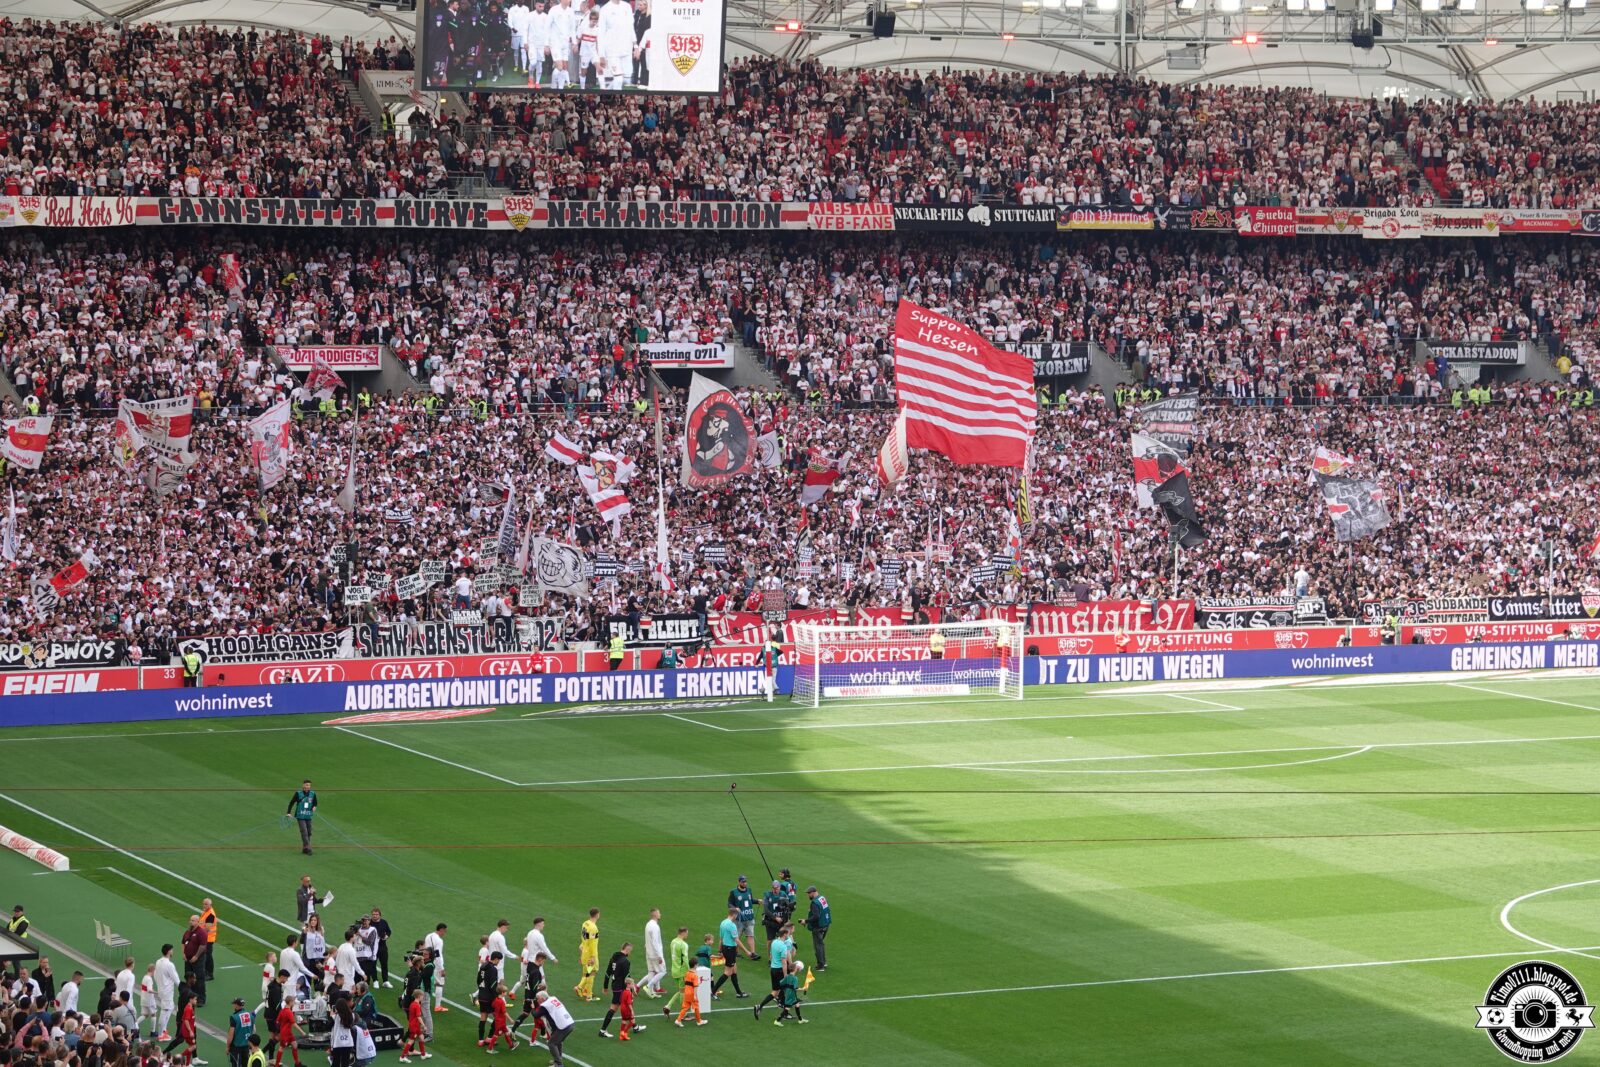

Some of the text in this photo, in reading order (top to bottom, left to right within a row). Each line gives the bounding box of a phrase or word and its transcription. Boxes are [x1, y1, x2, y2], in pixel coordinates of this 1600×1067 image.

[672, 8, 701, 16] KUTTER
[45, 194, 133, 227] Red Hots 96
[159, 197, 488, 229] CANNSTATTER KURVE
[547, 199, 782, 229] NECKARSTADION
[812, 202, 893, 215] ALBSTADT
[894, 207, 1057, 222] NECKAR-FILS STUTTGART
[1400, 208, 1419, 217] Loca
[815, 214, 893, 230] VFB-FANS
[918, 327, 978, 356] Hessen
[694, 347, 718, 359] 0711
[1051, 343, 1071, 359] ZU
[1033, 357, 1088, 376] STOREN!
[348, 586, 366, 594] VOGT
[1200, 598, 1251, 607] SCHWABEN
[1407, 601, 1427, 616] 36
[1154, 603, 1190, 631] 97
[1427, 613, 1488, 623] STUTTGART
[647, 618, 700, 640] BLEIBT
[1368, 627, 1379, 638] 36
[206, 632, 338, 656] HOOLIGANS
[983, 640, 994, 649] 35
[692, 650, 800, 669] JOKERSAR
[841, 647, 946, 664] JOKERSTA
[1292, 653, 1374, 670] wohninvest
[1450, 643, 1599, 671] GEMEINSAM MEHR
[163, 668, 176, 679] 33
[1066, 658, 1090, 684] ZU
[1098, 655, 1154, 682] NEUEN
[1162, 654, 1225, 680] WEGEN
[3, 672, 100, 696] EHEIM
[554, 674, 665, 702] POTENTIALE
[676, 670, 769, 698] ERKENNEN
[175, 692, 273, 712] wohninvest
